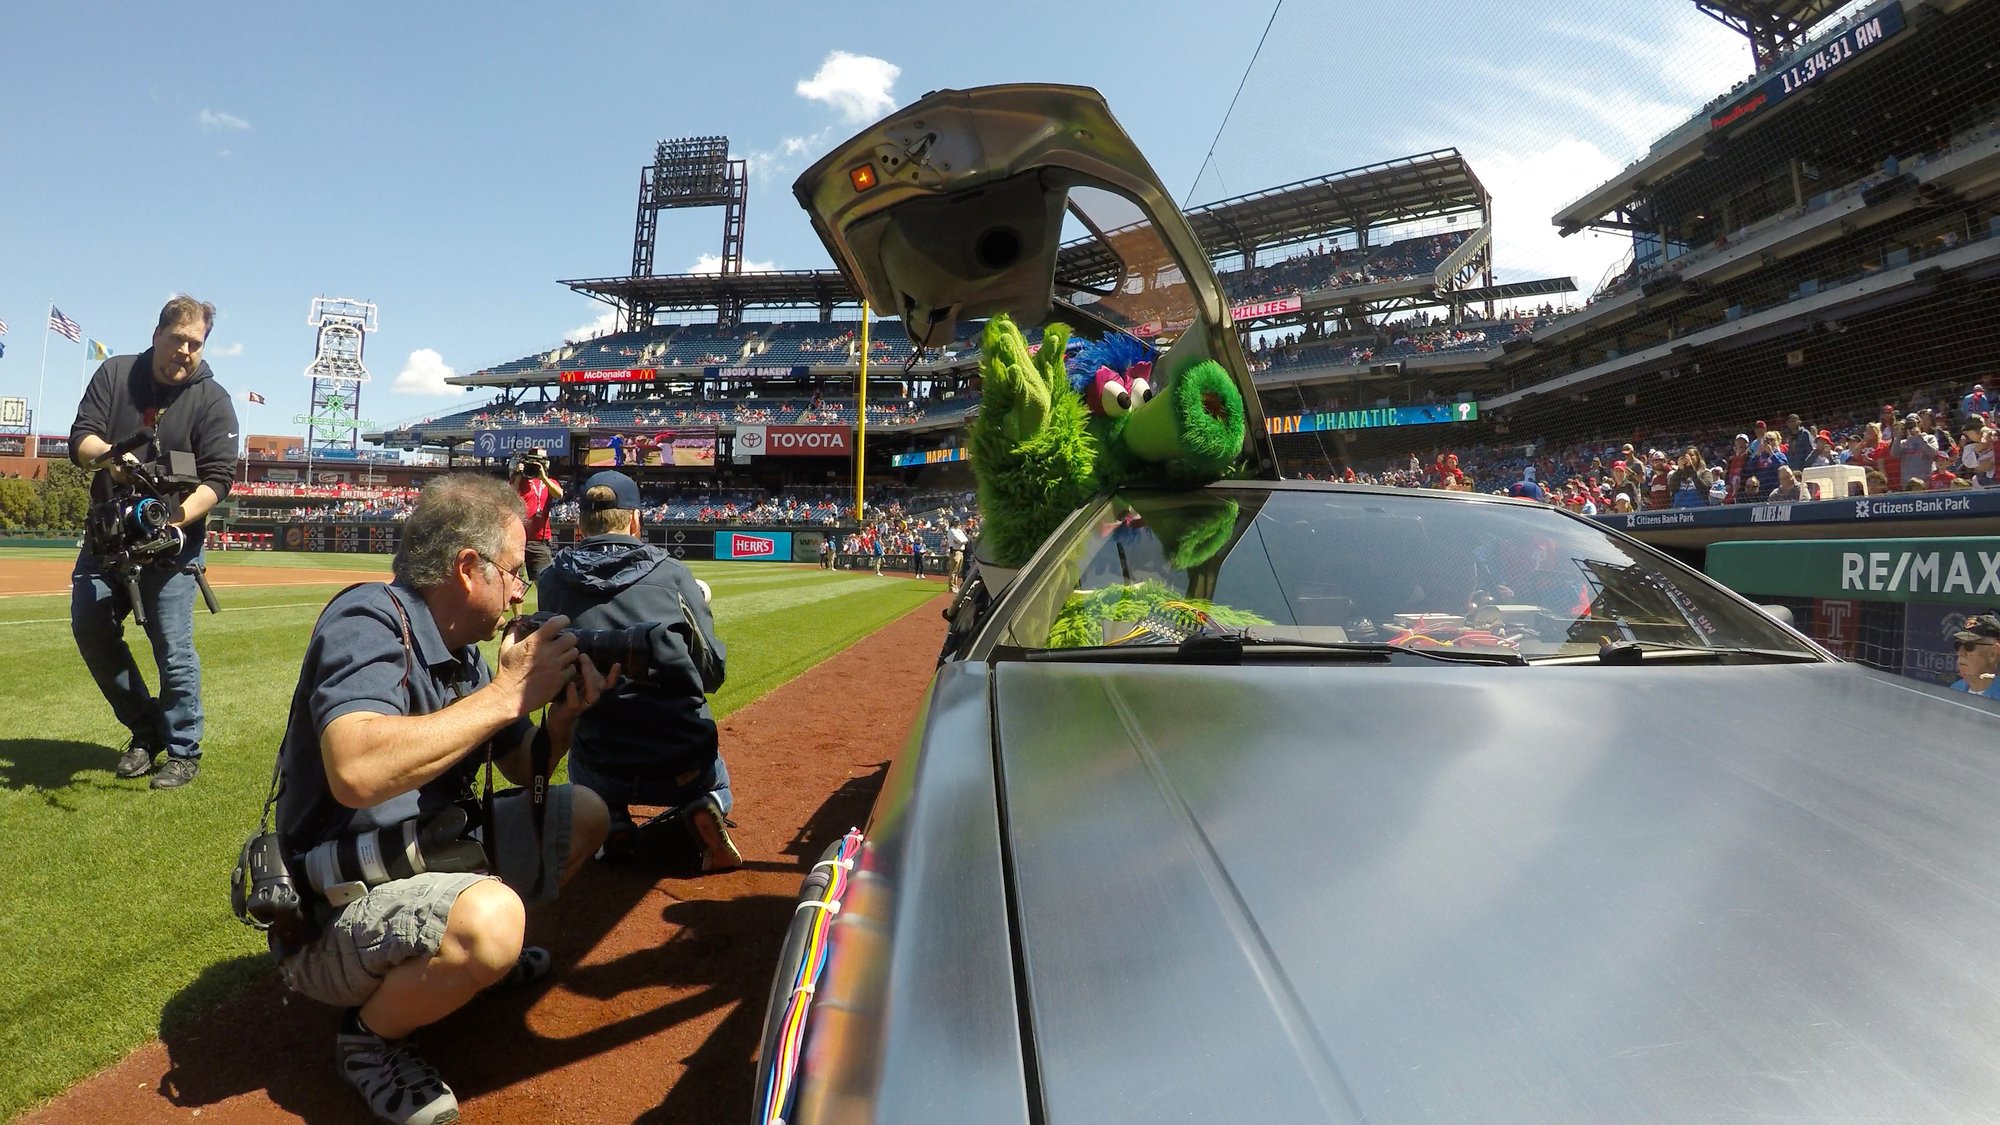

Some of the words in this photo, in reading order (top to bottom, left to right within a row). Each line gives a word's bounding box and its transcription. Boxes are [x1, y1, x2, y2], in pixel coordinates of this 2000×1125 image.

[1781, 37, 1852, 94] 11:34:31
[1855, 17, 1882, 49] AM
[1231, 301, 1287, 318] HILLIES
[584, 370, 631, 379] McDonald's
[718, 368, 756, 376] LISCIO'S
[757, 367, 793, 376] BAKERY
[500, 435, 564, 449] LifeBrand
[771, 433, 844, 448] TOYOTA
[926, 448, 953, 464] HAPPY
[1316, 408, 1397, 430] PHANATIC
[1872, 501, 1913, 514] Citizens
[1915, 498, 1943, 512] Bank
[1945, 496, 1970, 510] Park
[1636, 515, 1661, 525] Citizens
[1662, 514, 1679, 524] Bank
[1679, 512, 1694, 523] Park
[1751, 506, 1791, 523] PHILLIES.COM
[736, 540, 769, 553] HERR'S
[1842, 551, 2000, 595] RE/MAX
[535, 775, 544, 804] EOS
